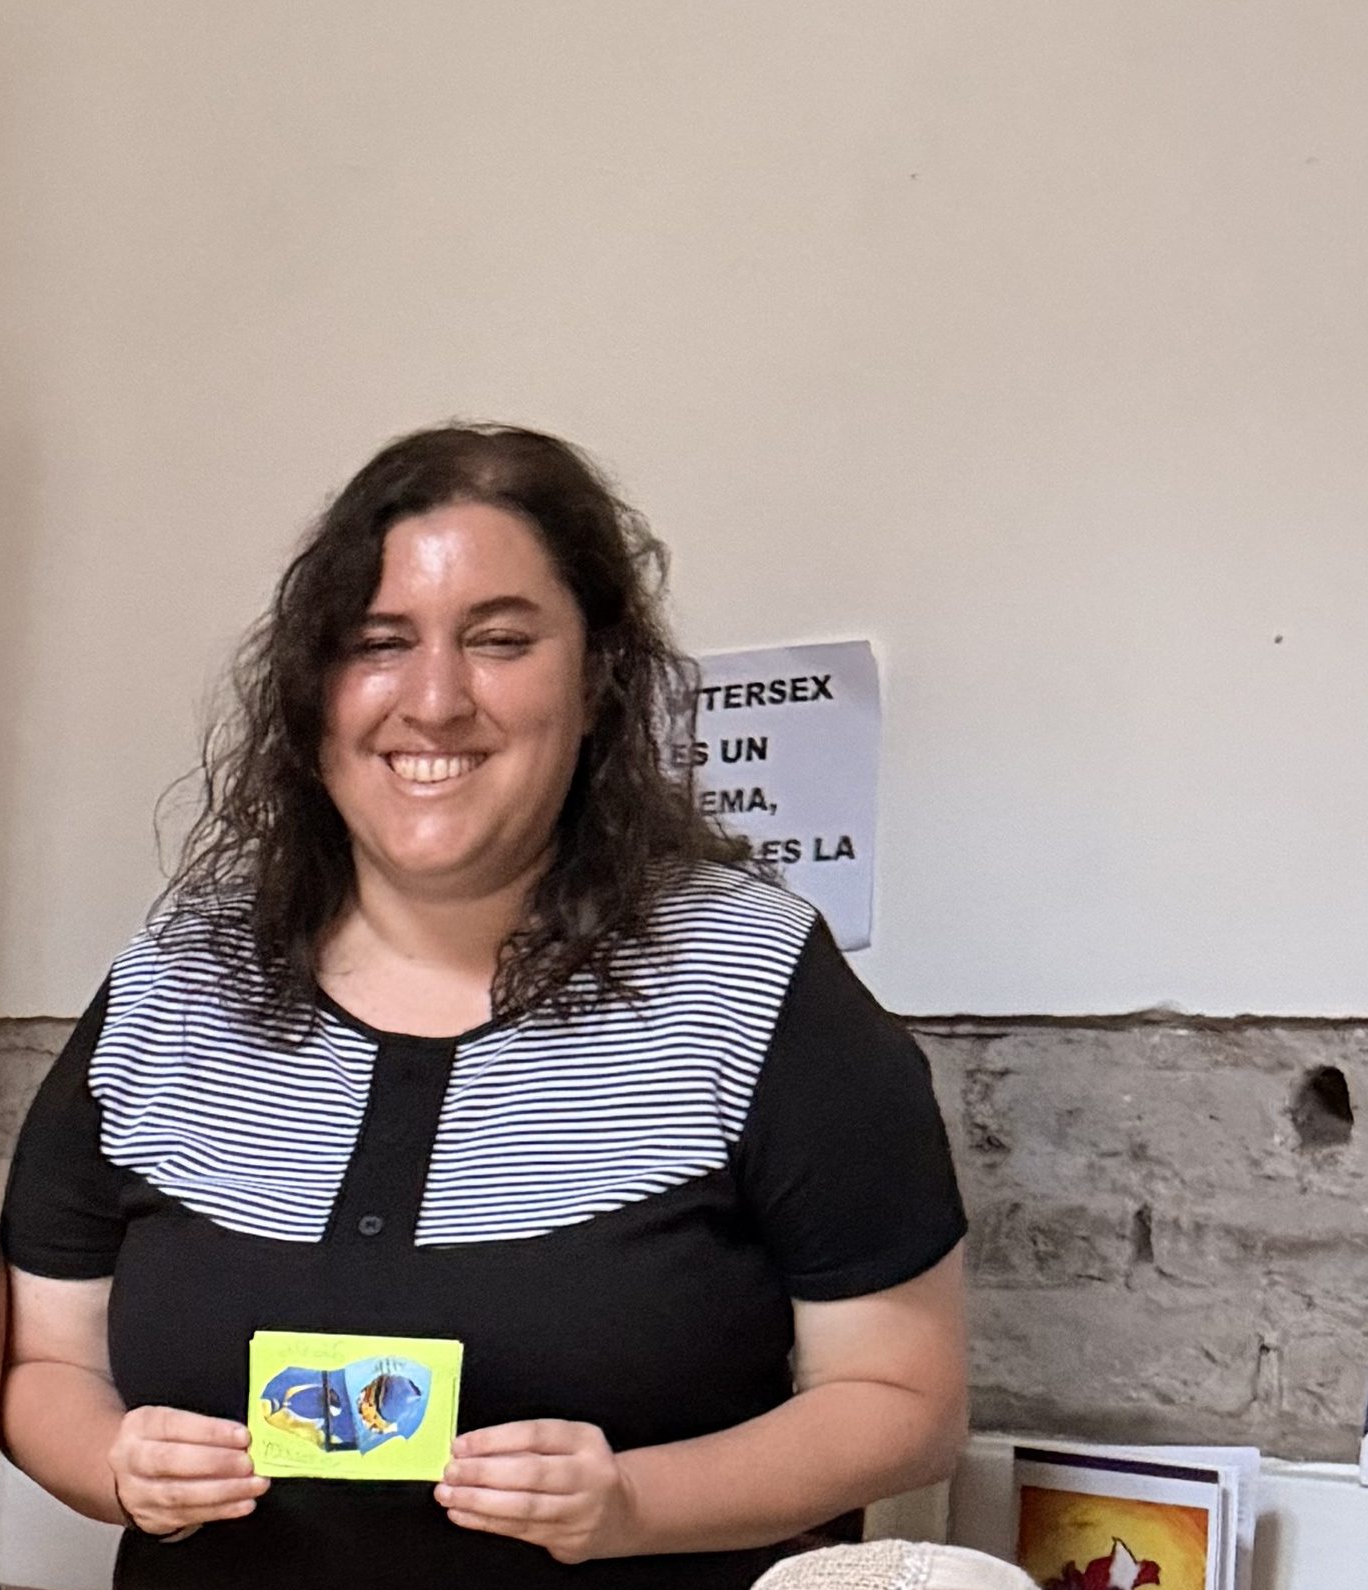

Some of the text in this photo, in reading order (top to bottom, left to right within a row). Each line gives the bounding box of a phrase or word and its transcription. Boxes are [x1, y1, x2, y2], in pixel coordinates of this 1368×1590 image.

[699, 674, 834, 711] TERSEX
[720, 735, 768, 763] UN
[813, 834, 856, 862] LA
